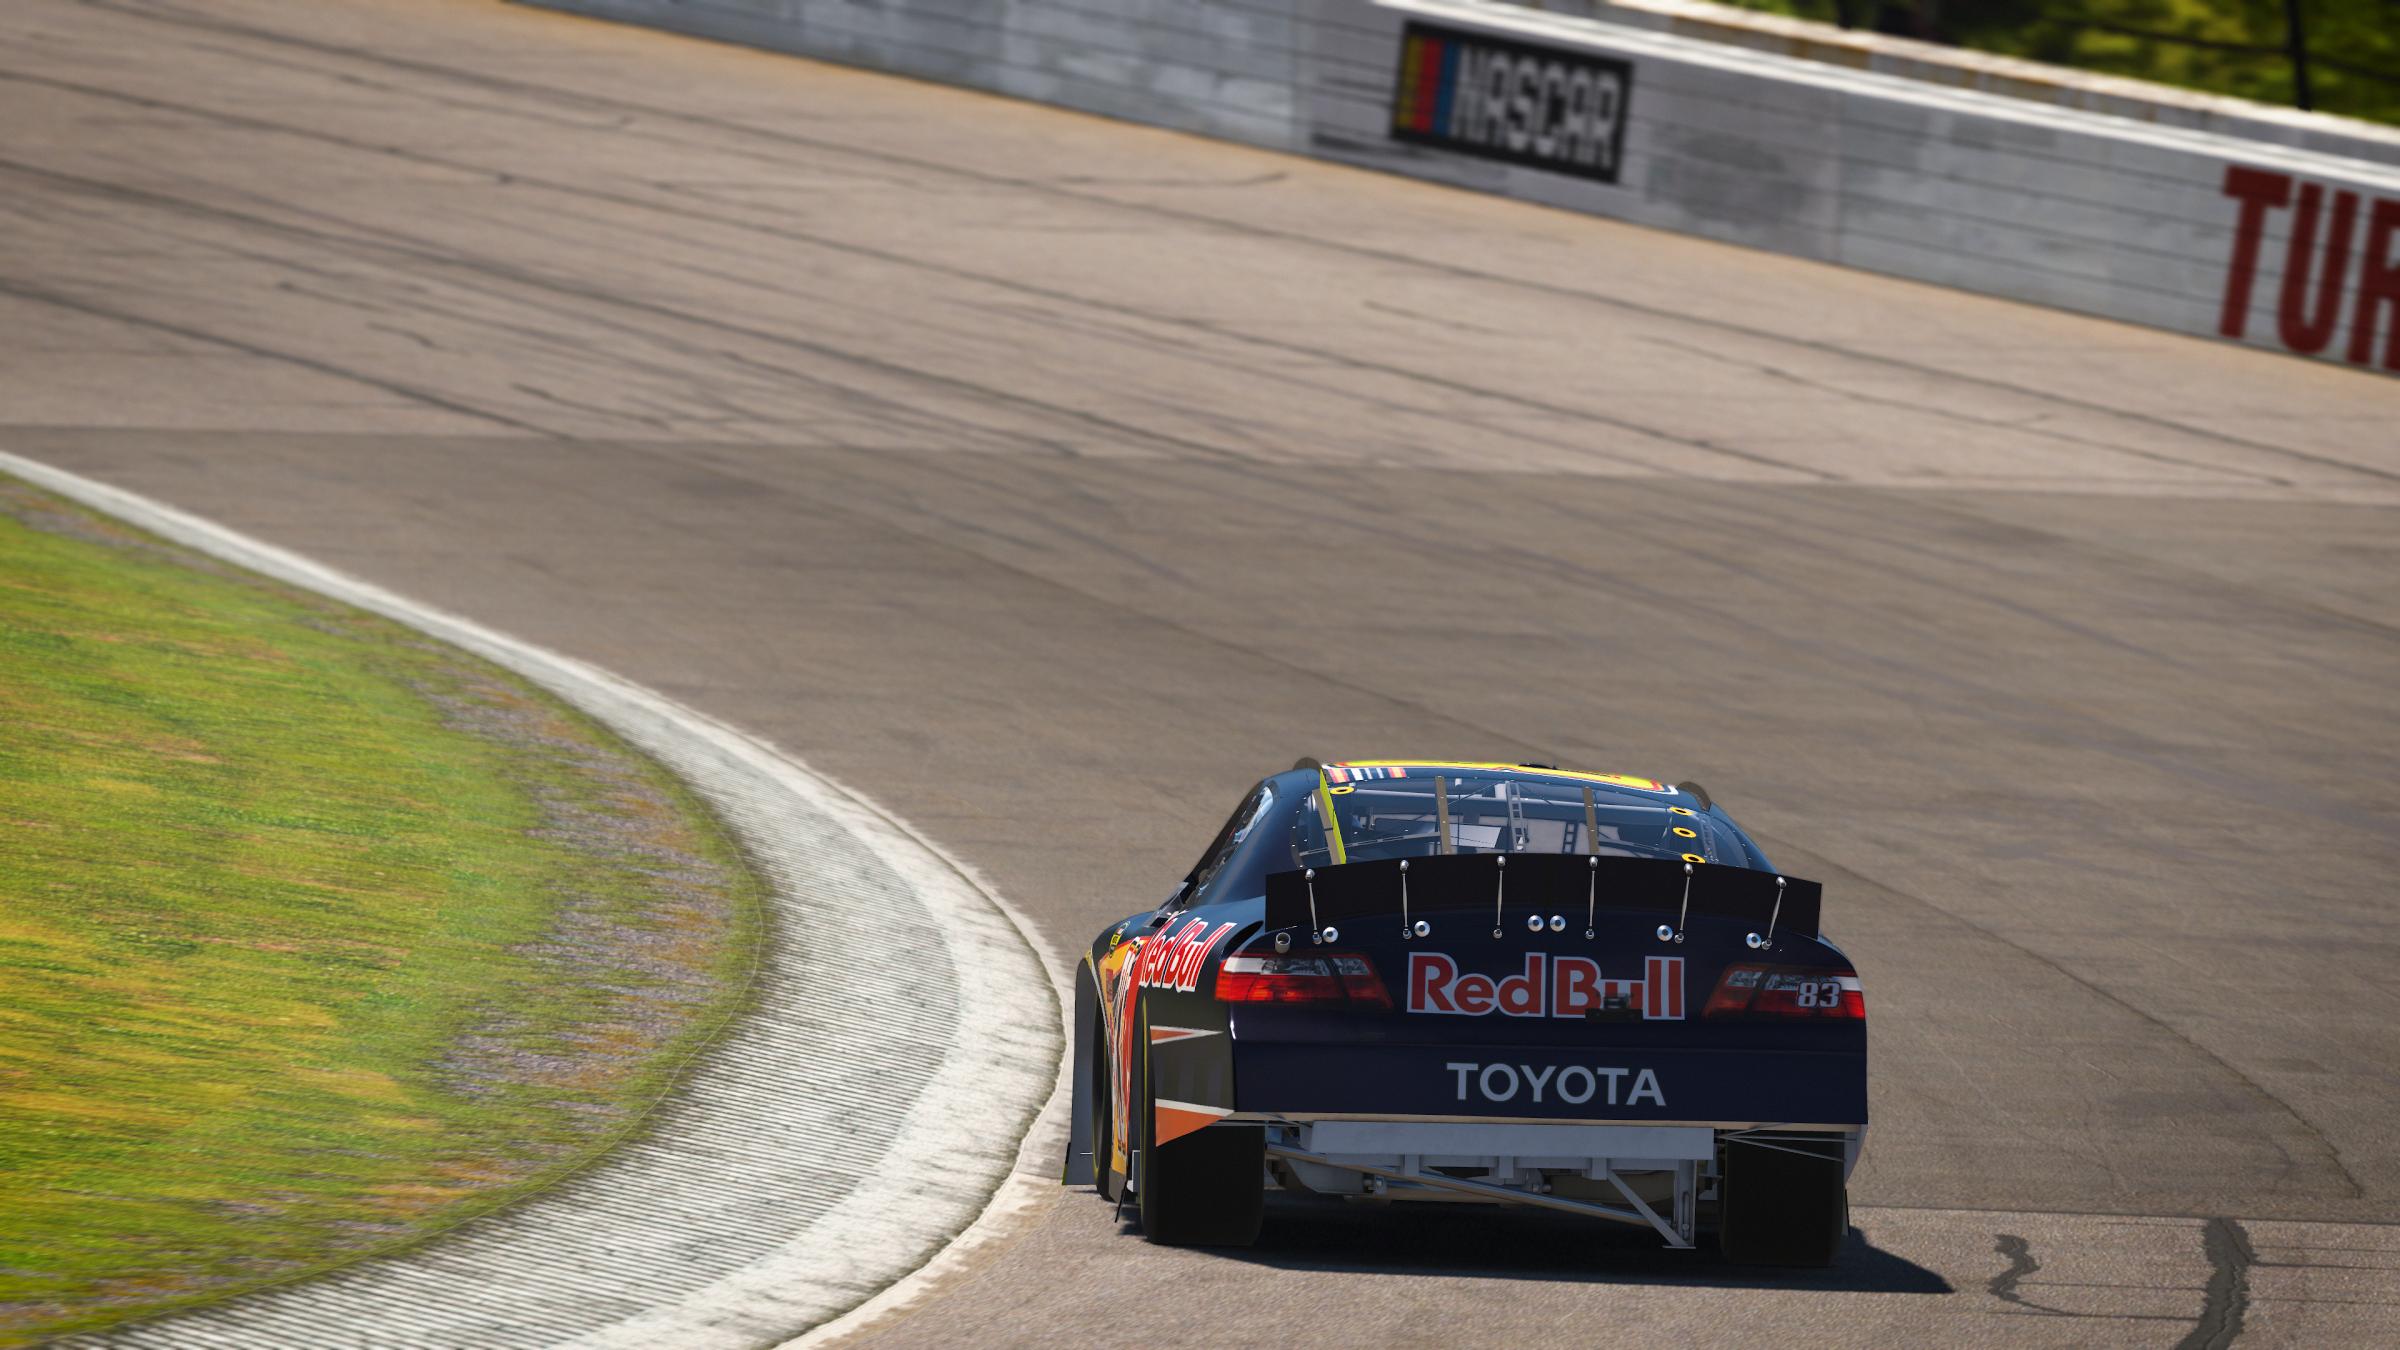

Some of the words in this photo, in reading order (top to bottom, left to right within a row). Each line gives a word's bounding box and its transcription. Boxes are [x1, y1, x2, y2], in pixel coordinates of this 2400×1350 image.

[1449, 44, 1620, 168] NASCAR
[1161, 920, 1238, 993] Bull
[1406, 952, 1546, 1017] Red
[1552, 955, 1685, 1020] Bull
[1797, 982, 1841, 1008] 83
[1446, 1062, 1666, 1107] TOYOTA
